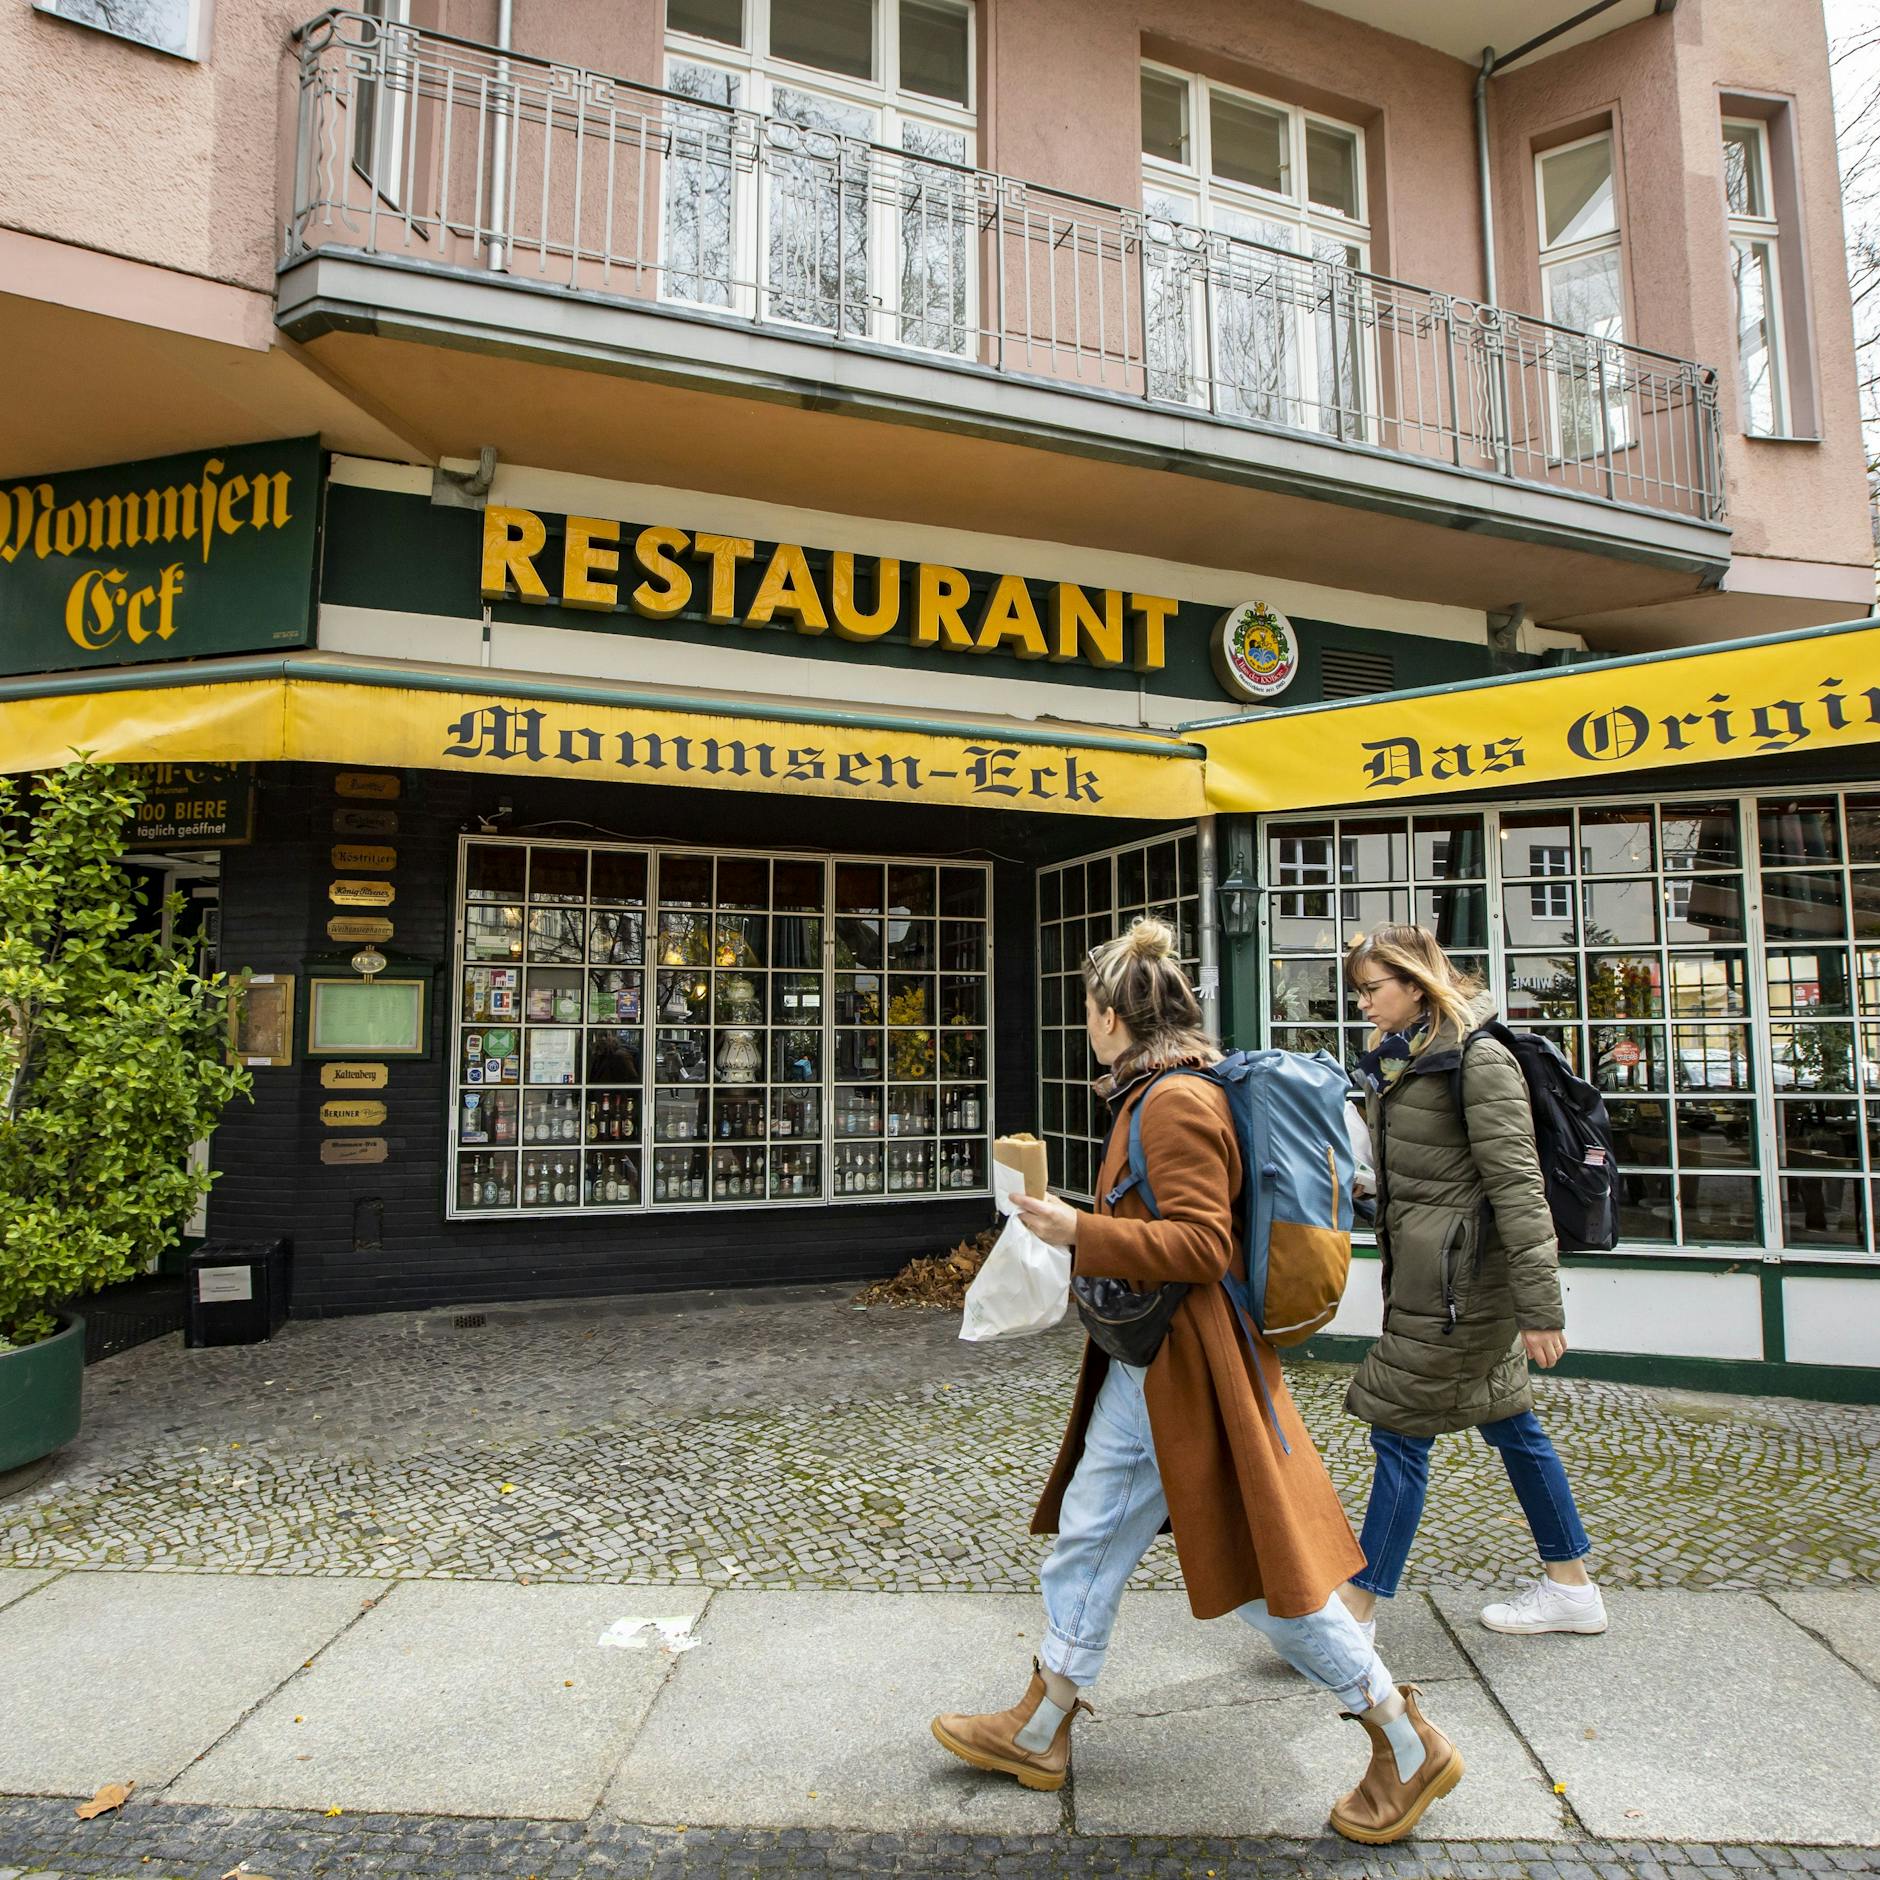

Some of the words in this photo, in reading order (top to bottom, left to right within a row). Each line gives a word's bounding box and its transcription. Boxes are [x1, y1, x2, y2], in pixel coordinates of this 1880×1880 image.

[65, 562, 185, 650] Eck
[481, 504, 1179, 673] RESTAURANT
[443, 705, 1104, 803] Mommsen-Eck
[1362, 736, 1526, 789] Das
[136, 803, 165, 821] 100
[175, 800, 227, 820] BIERE
[137, 823, 175, 839] täglich
[177, 822, 226, 837] geöffnet
[332, 1069, 377, 1082] Kaltenberg
[324, 1109, 360, 1118] BERLINER
